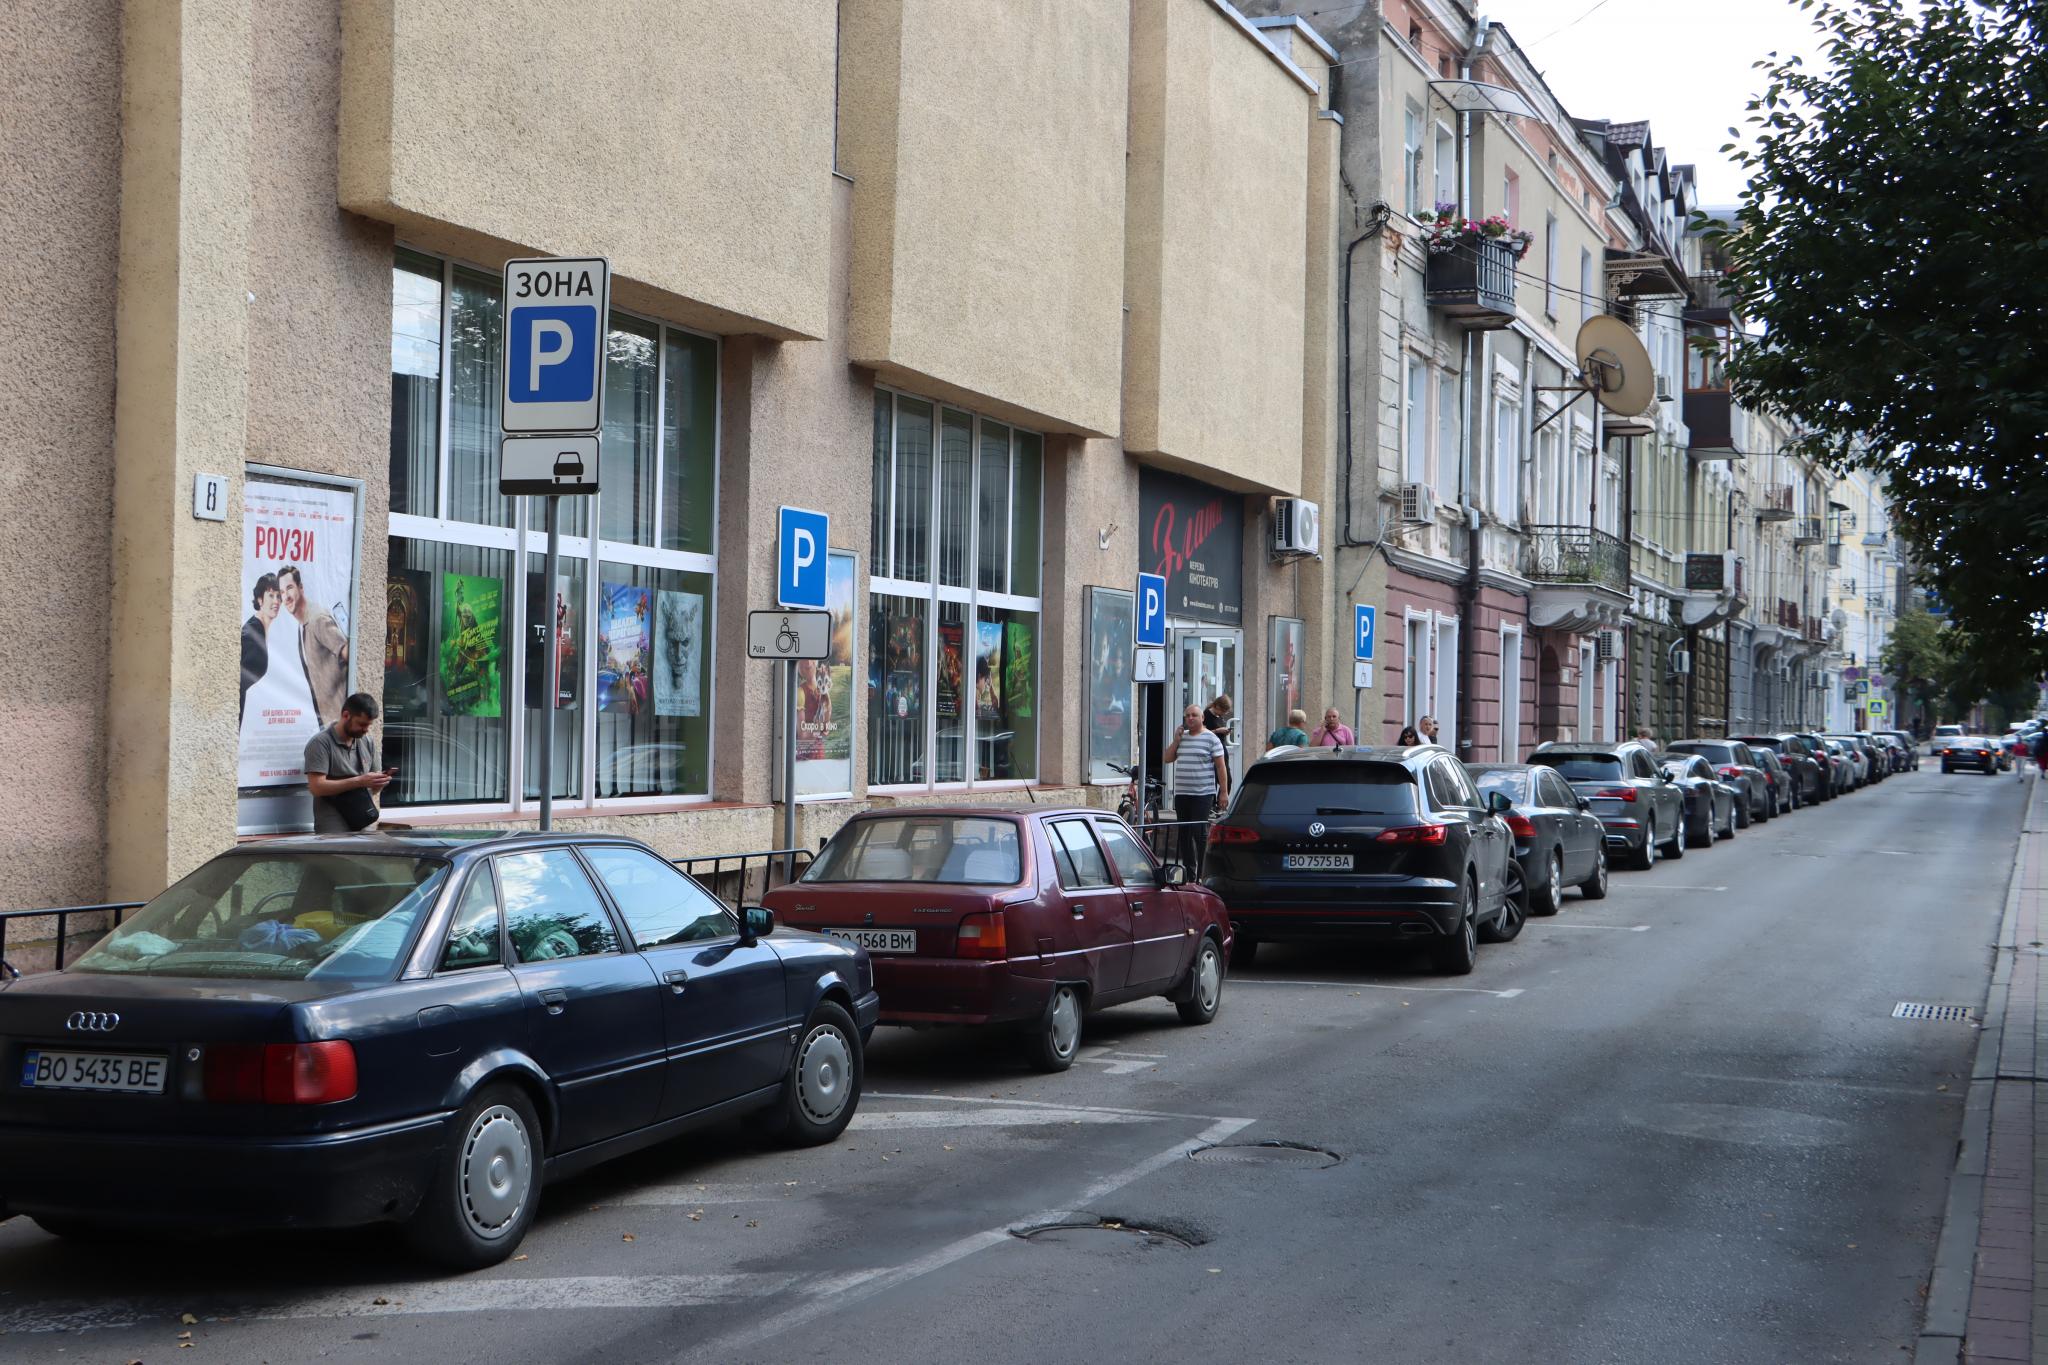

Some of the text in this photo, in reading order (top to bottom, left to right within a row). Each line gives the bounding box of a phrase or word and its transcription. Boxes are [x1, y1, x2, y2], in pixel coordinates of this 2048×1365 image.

[515, 270, 594, 298] ЗОНА
[529, 319, 574, 392] P
[207, 481, 216, 511] 8
[255, 525, 314, 562] РОУЗИ
[793, 528, 816, 587] P
[1145, 587, 1159, 631] P
[1360, 615, 1370, 649] P
[800, 720, 819, 733] Скоро
[1289, 856, 1350, 867] BO 7575 BA
[856, 933, 887, 949] 1568
[891, 933, 912, 949] BM
[36, 1056, 161, 1087] BO 5435 BE
